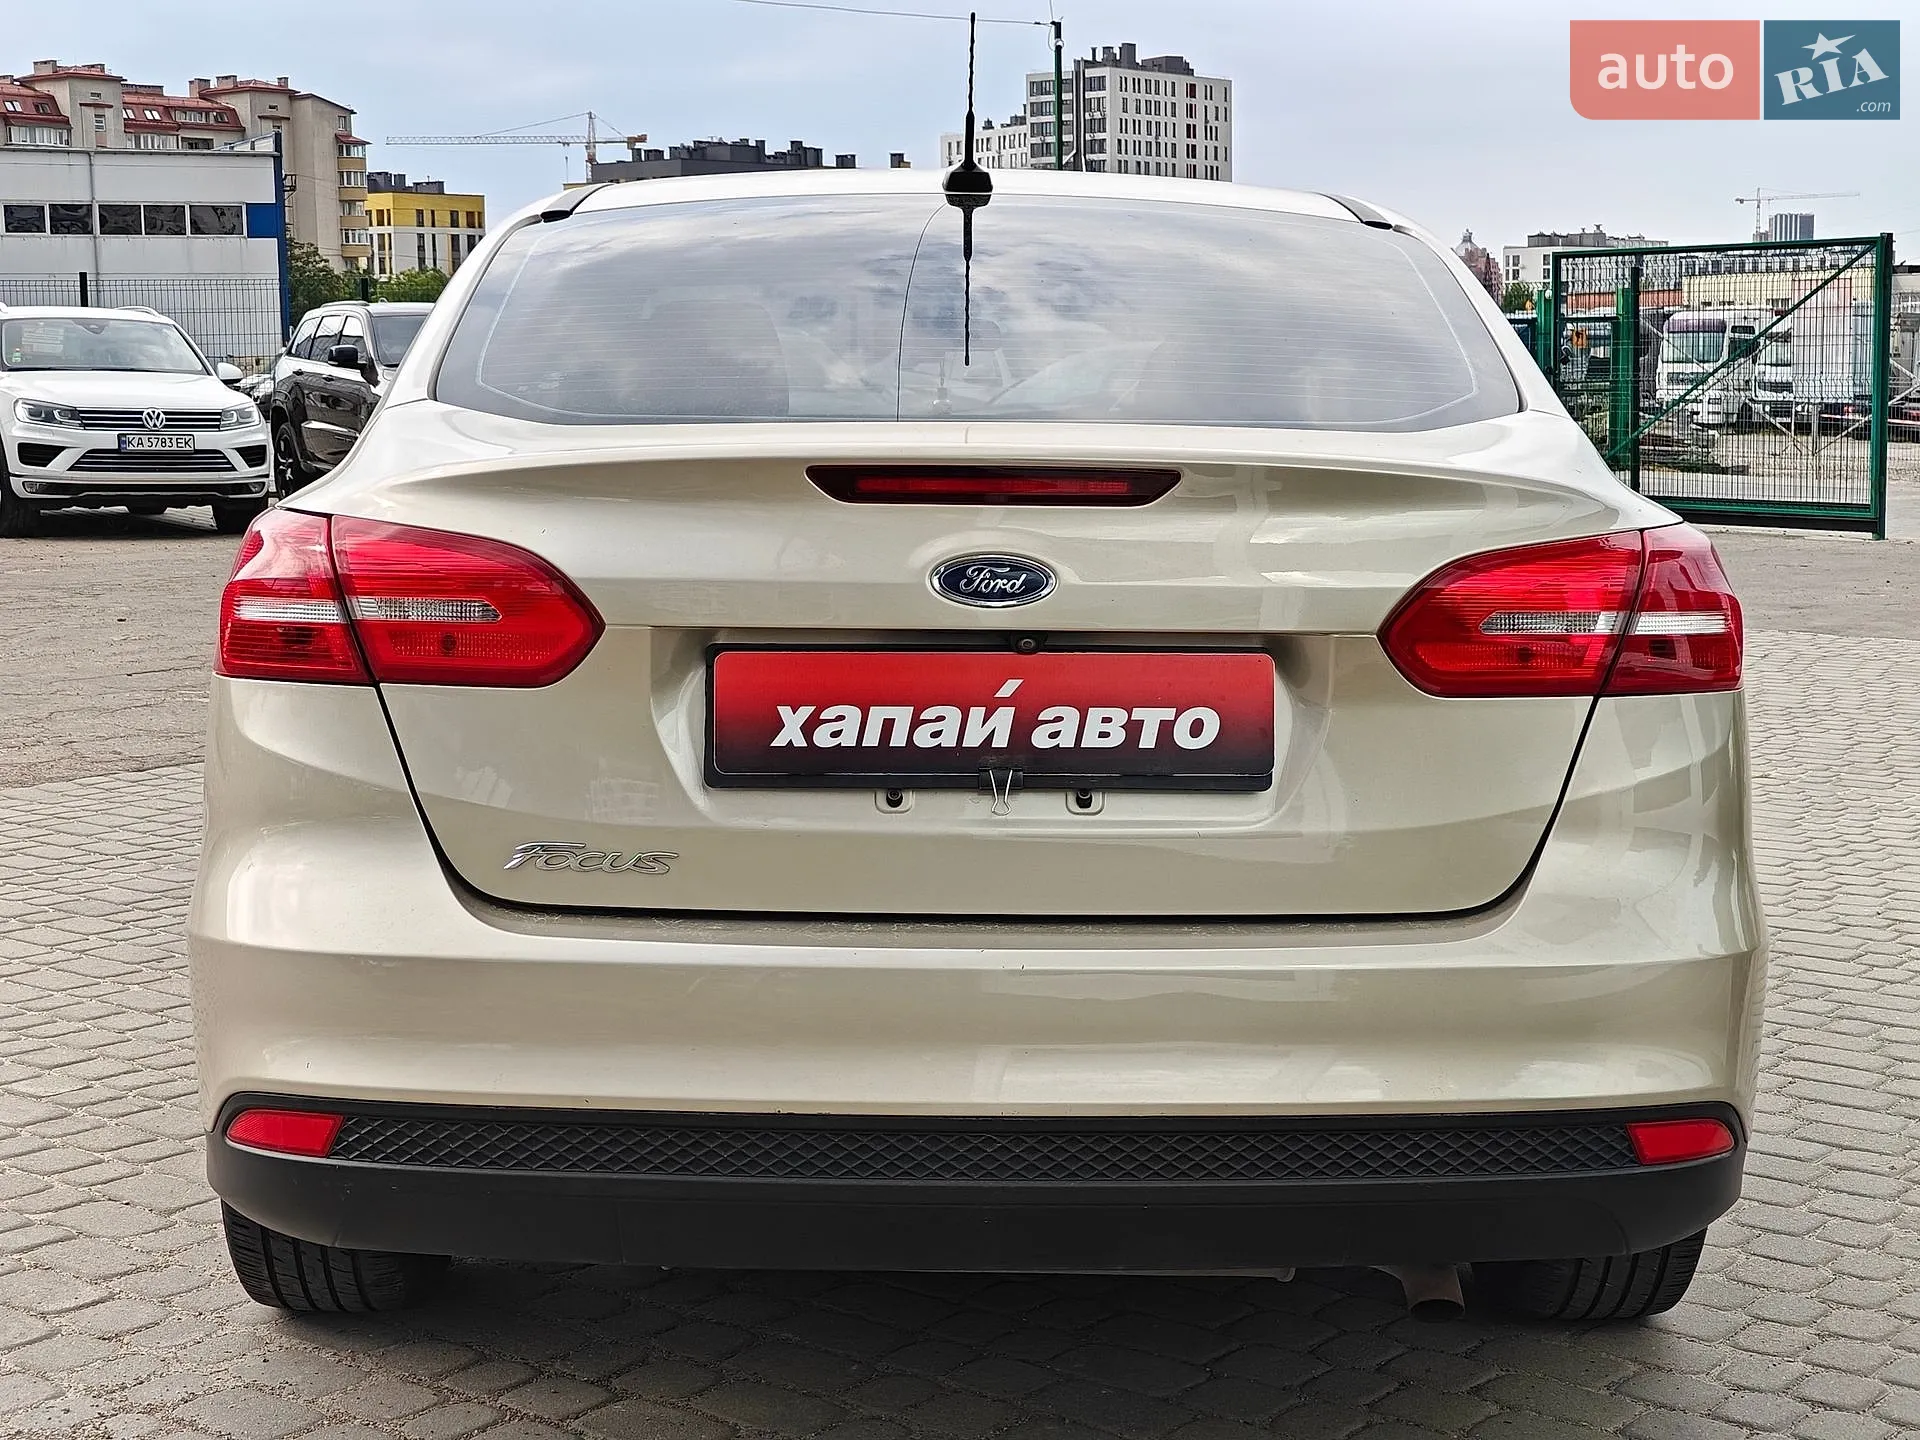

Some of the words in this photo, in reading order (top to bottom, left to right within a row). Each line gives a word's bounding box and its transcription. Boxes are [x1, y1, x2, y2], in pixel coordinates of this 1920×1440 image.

[127, 437, 144, 448] KA
[147, 437, 173, 448] 5783
[176, 437, 193, 449] EK
[959, 565, 1027, 594] Ford
[1030, 706, 1221, 749] авто
